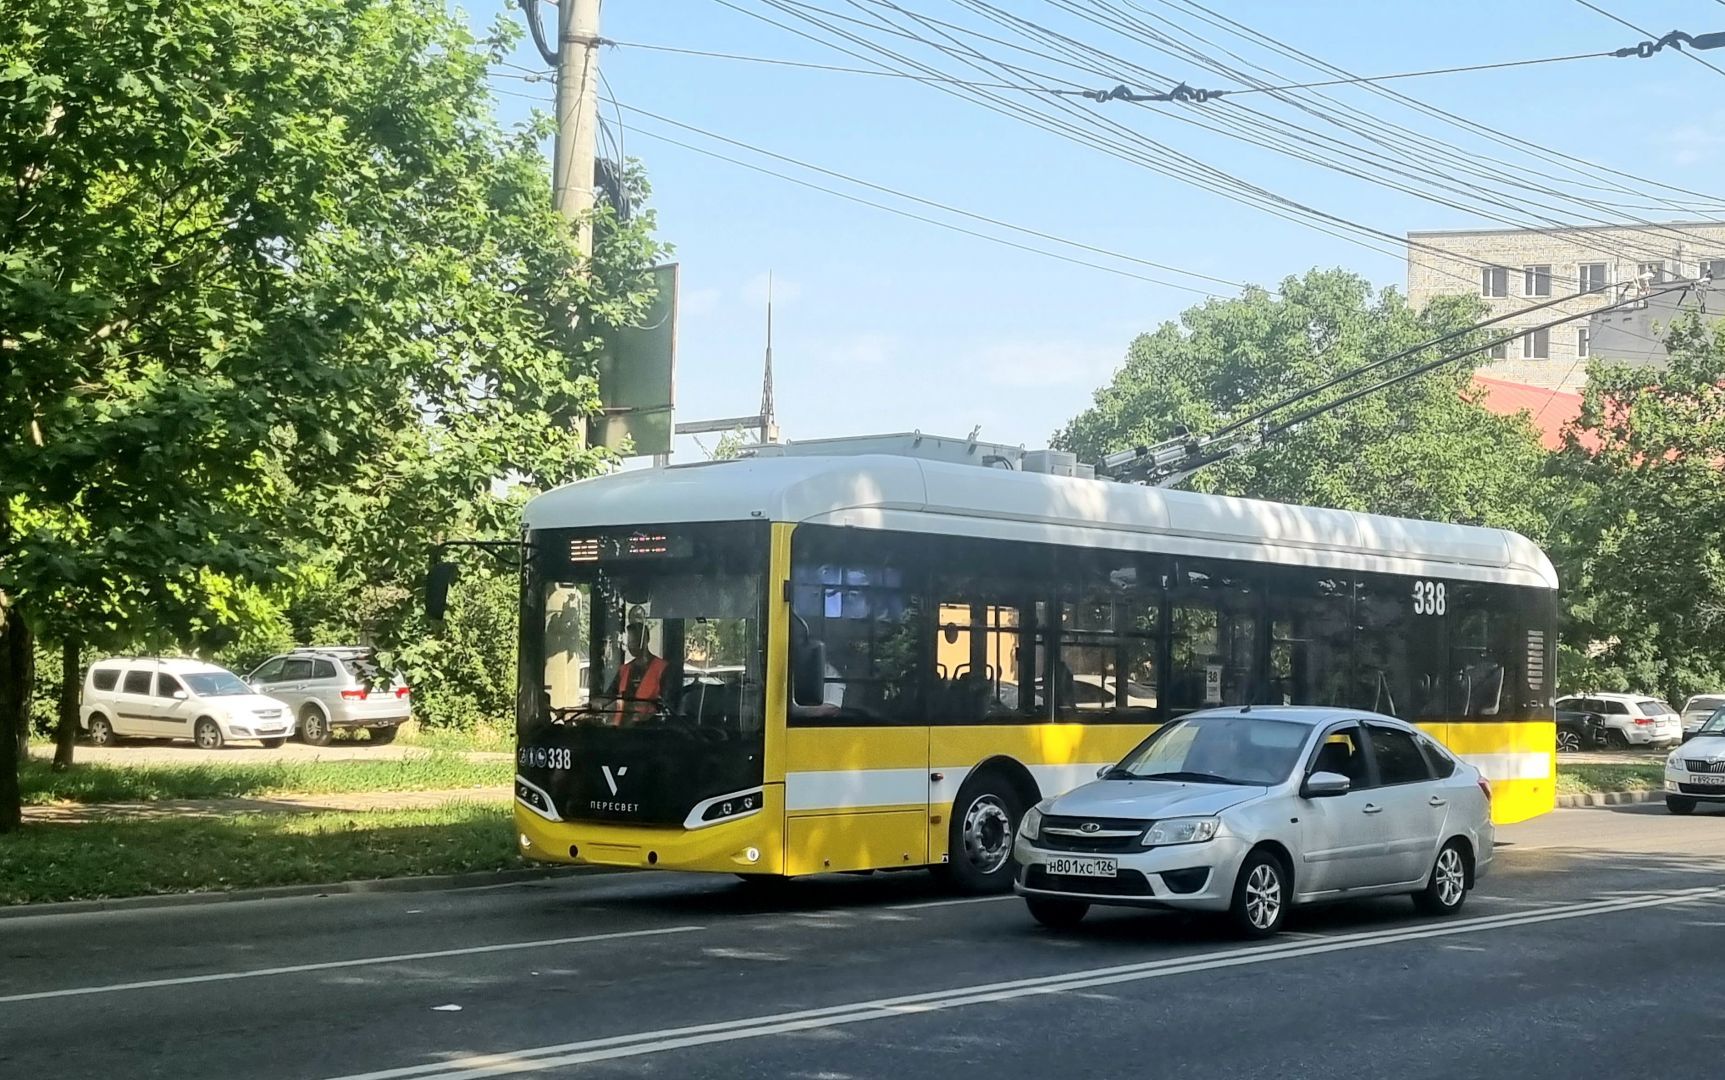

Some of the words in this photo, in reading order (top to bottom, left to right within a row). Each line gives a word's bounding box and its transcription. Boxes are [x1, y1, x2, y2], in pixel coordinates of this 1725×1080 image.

[1414, 581, 1446, 616] 338
[547, 747, 572, 770] 338
[590, 800, 640, 812] ПЕРЕСВЕТ
